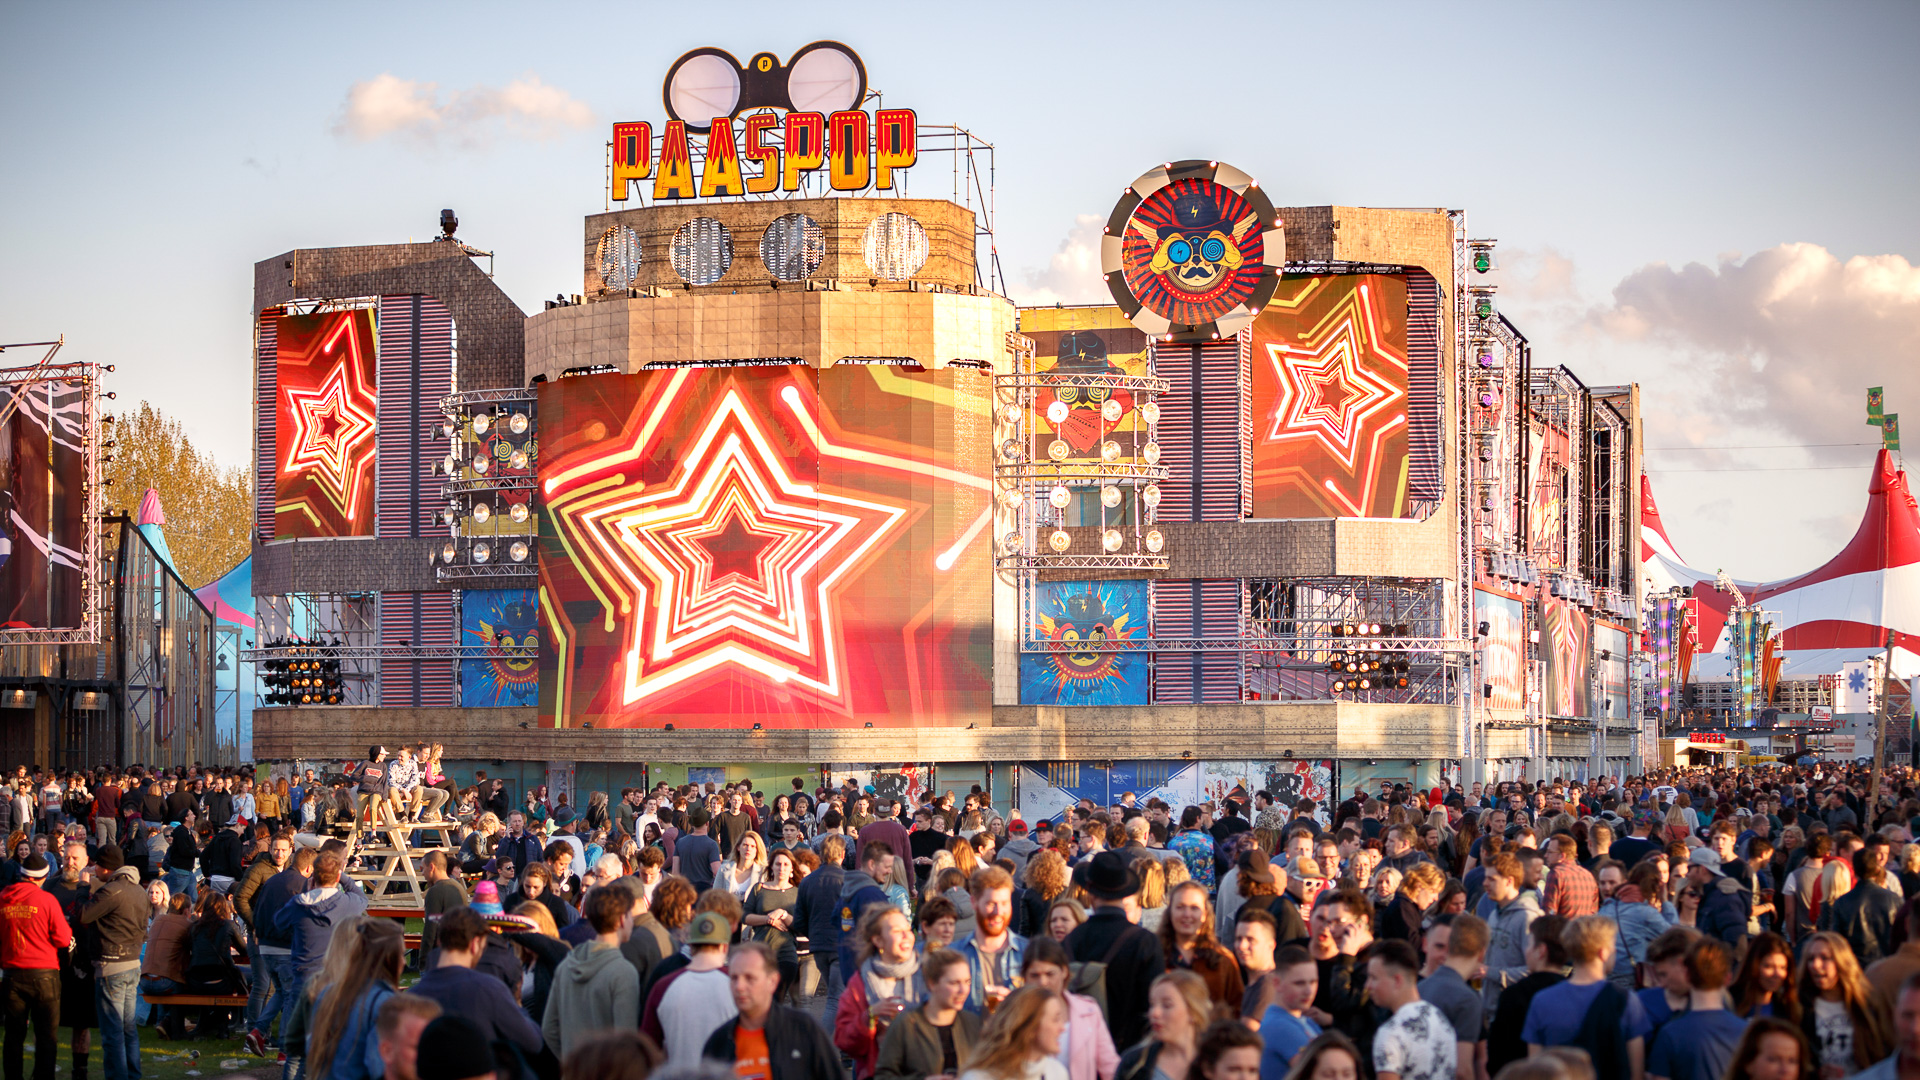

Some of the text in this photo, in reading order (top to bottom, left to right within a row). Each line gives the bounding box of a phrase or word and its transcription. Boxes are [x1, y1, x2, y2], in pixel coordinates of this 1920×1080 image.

[612, 108, 918, 201] PAASPOP
[1818, 674, 1842, 689] FIRST
[1790, 720, 1848, 728] EMERGENCY
[1690, 732, 1726, 744] WAFELS
